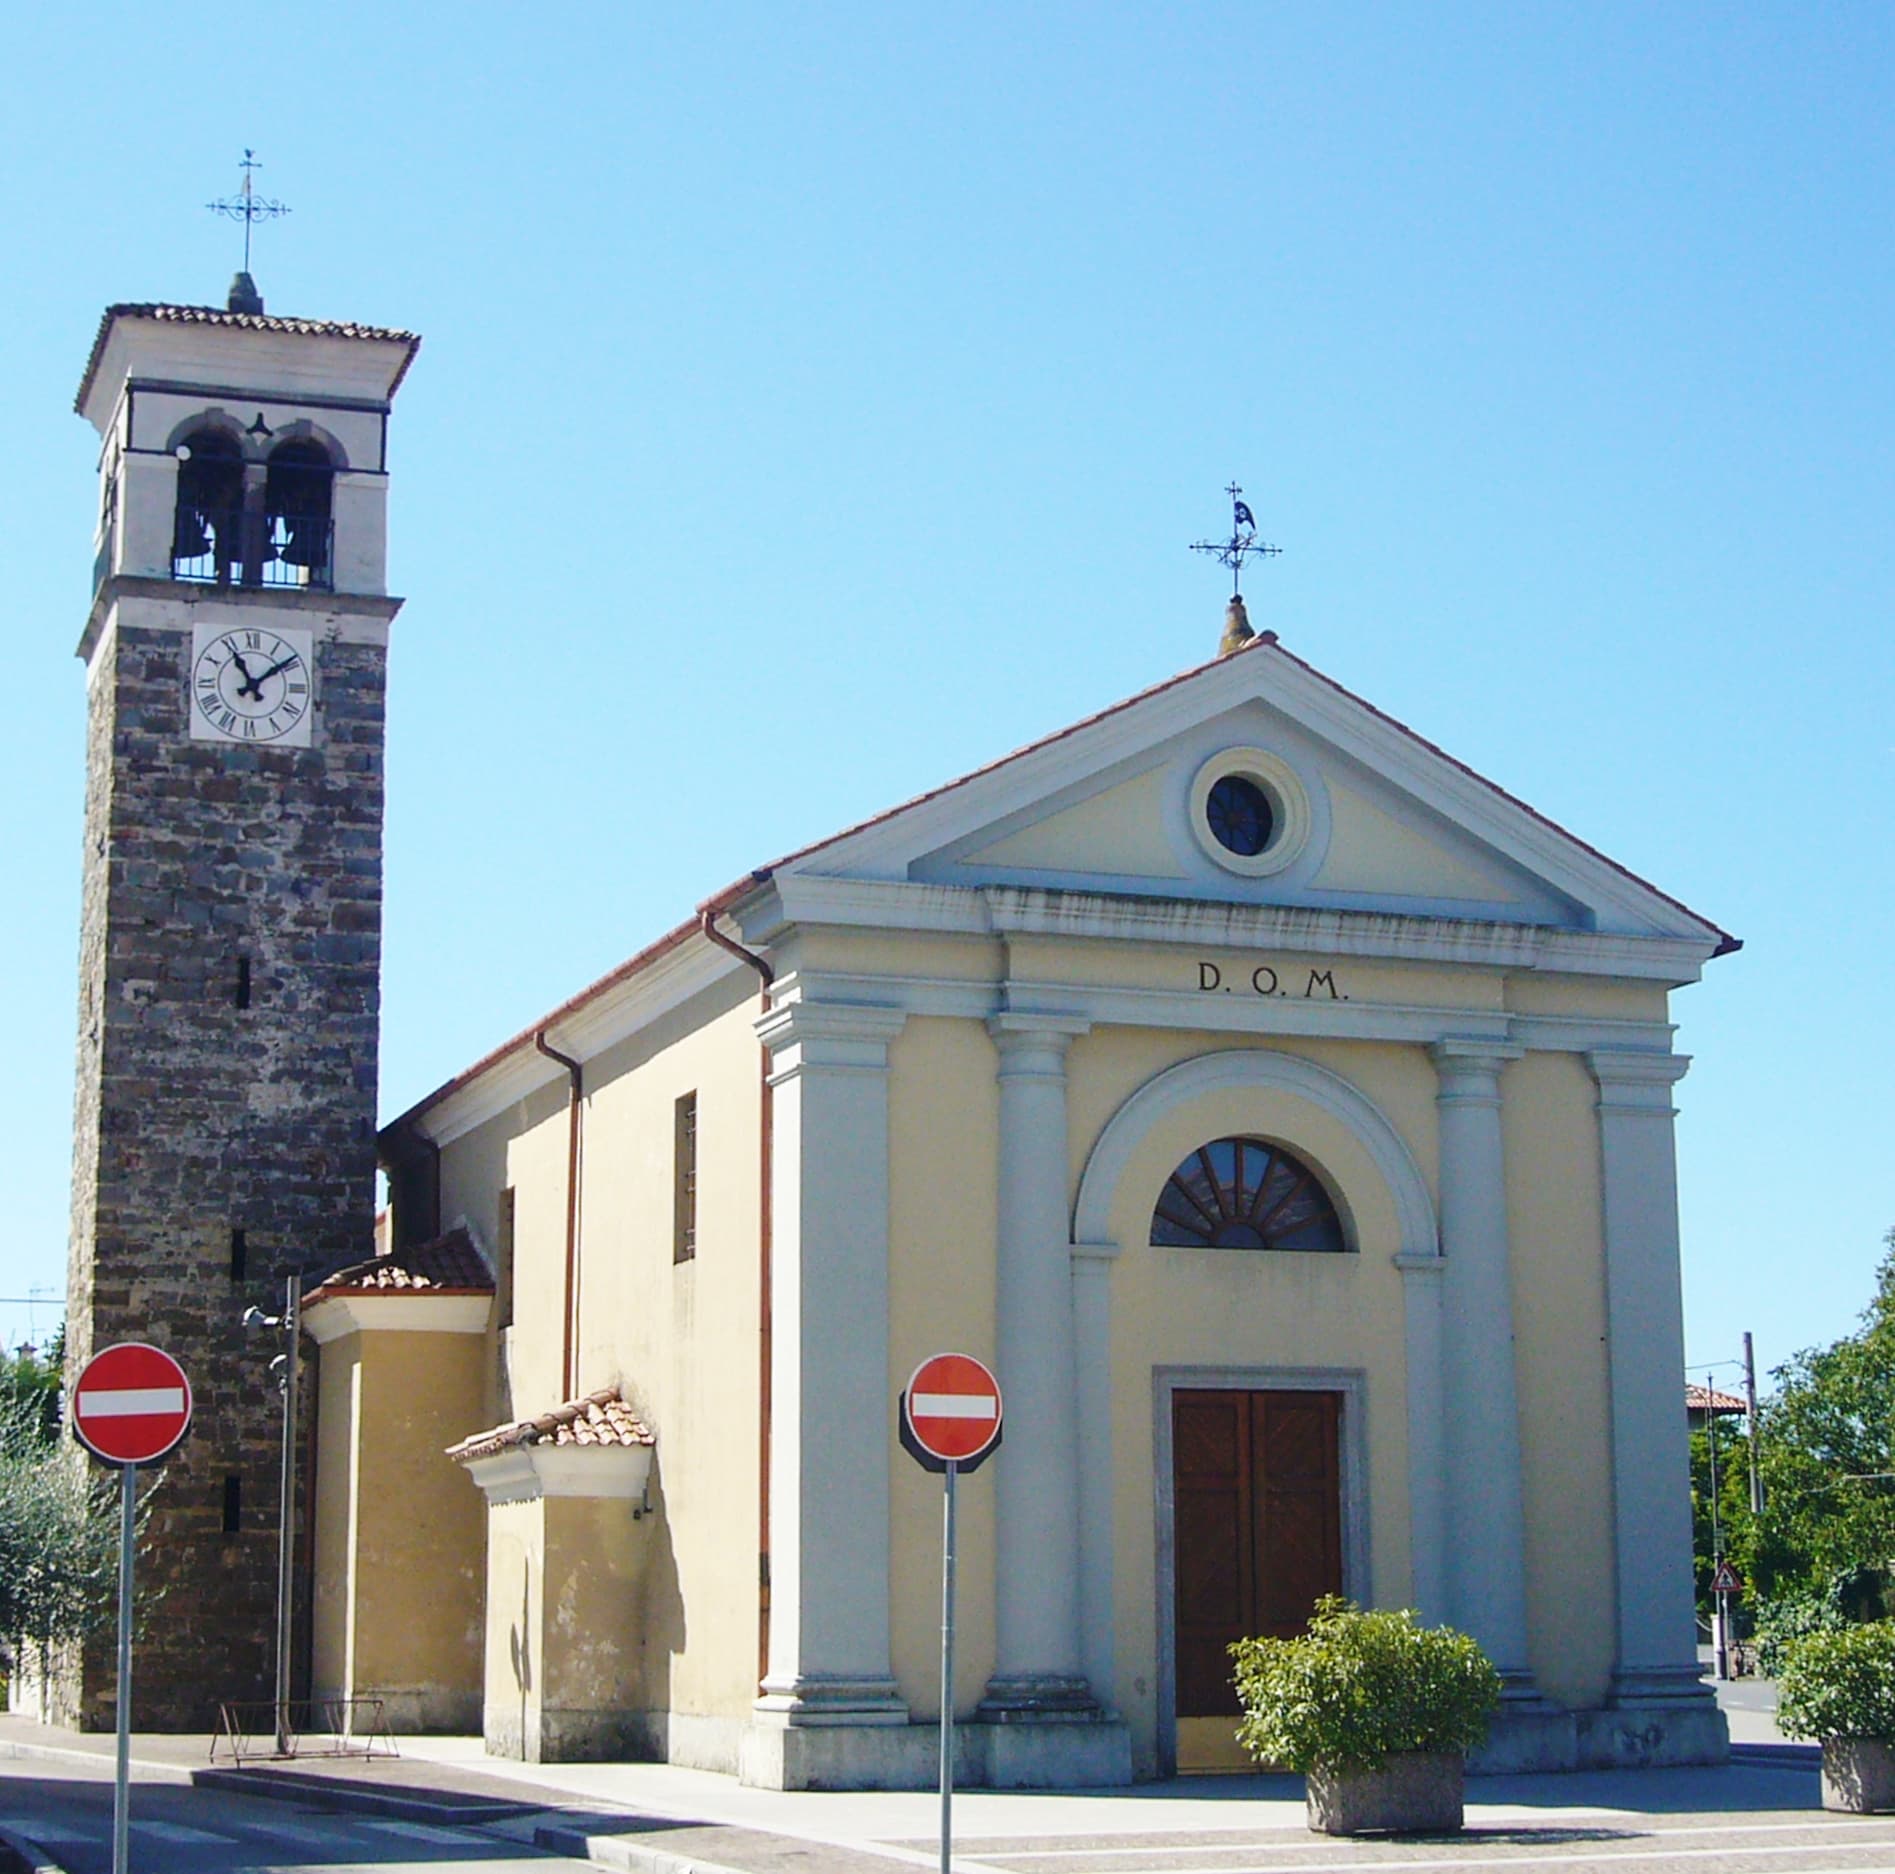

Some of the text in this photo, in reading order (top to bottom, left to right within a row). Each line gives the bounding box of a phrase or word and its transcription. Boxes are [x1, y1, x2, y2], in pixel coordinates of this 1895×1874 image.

[245, 631, 261, 650] XII
[270, 641, 281, 656] I
[204, 653, 222, 668] X
[197, 677, 216, 689] IX
[288, 683, 307, 694] III
[200, 693, 223, 716] VIII
[282, 701, 301, 719] IV
[218, 711, 237, 732] VII
[244, 719, 256, 738] VI
[269, 717, 283, 734] V
